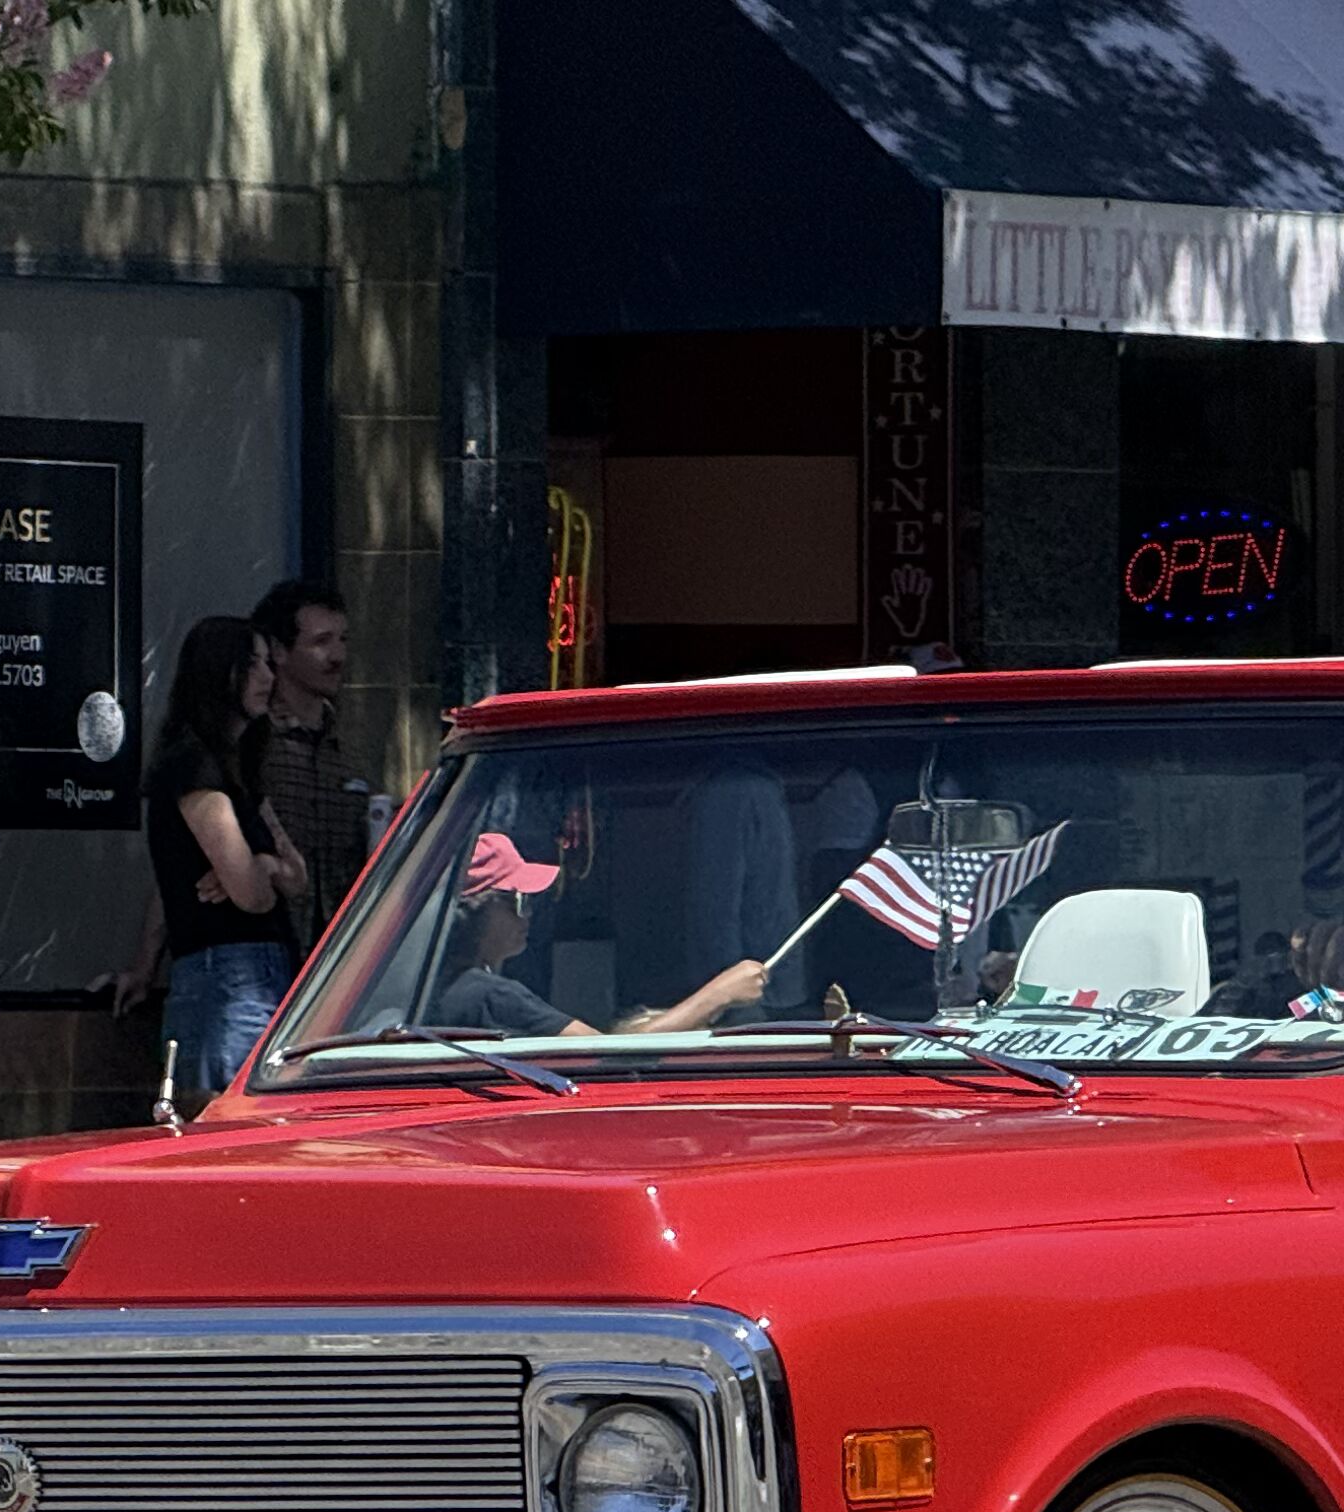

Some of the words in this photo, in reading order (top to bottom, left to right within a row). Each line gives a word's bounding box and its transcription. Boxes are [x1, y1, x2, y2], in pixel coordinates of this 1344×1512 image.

[965, 219, 1100, 318] LITTLE
[4, 563, 56, 583] RETAIL
[57, 565, 106, 585] SPACE
[1124, 528, 1286, 604] OPEN
[1157, 1020, 1267, 1055] 65
